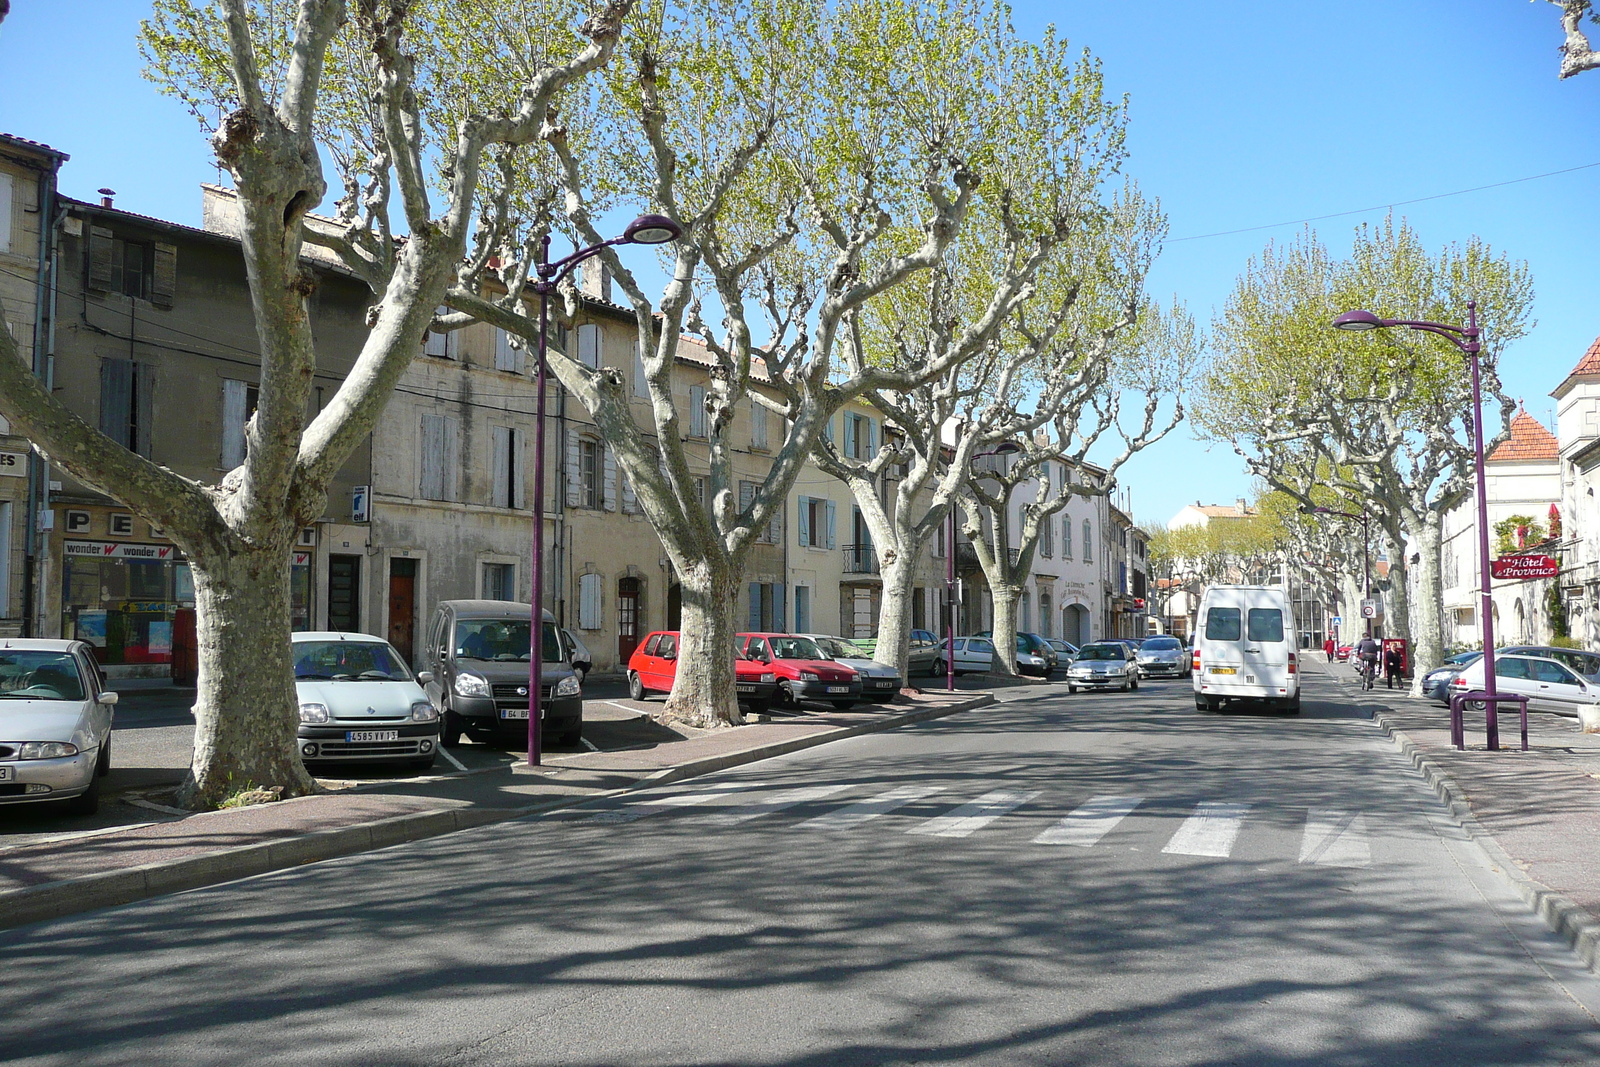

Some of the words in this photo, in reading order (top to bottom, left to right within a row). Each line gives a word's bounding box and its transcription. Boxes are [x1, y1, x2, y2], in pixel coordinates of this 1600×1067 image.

[353, 513, 364, 521] elf
[67, 544, 101, 554] wonder
[123, 547, 155, 557] wonder
[1511, 556, 1546, 567] Hôtel
[1503, 567, 1554, 577] Provence
[386, 732, 396, 740] 13
